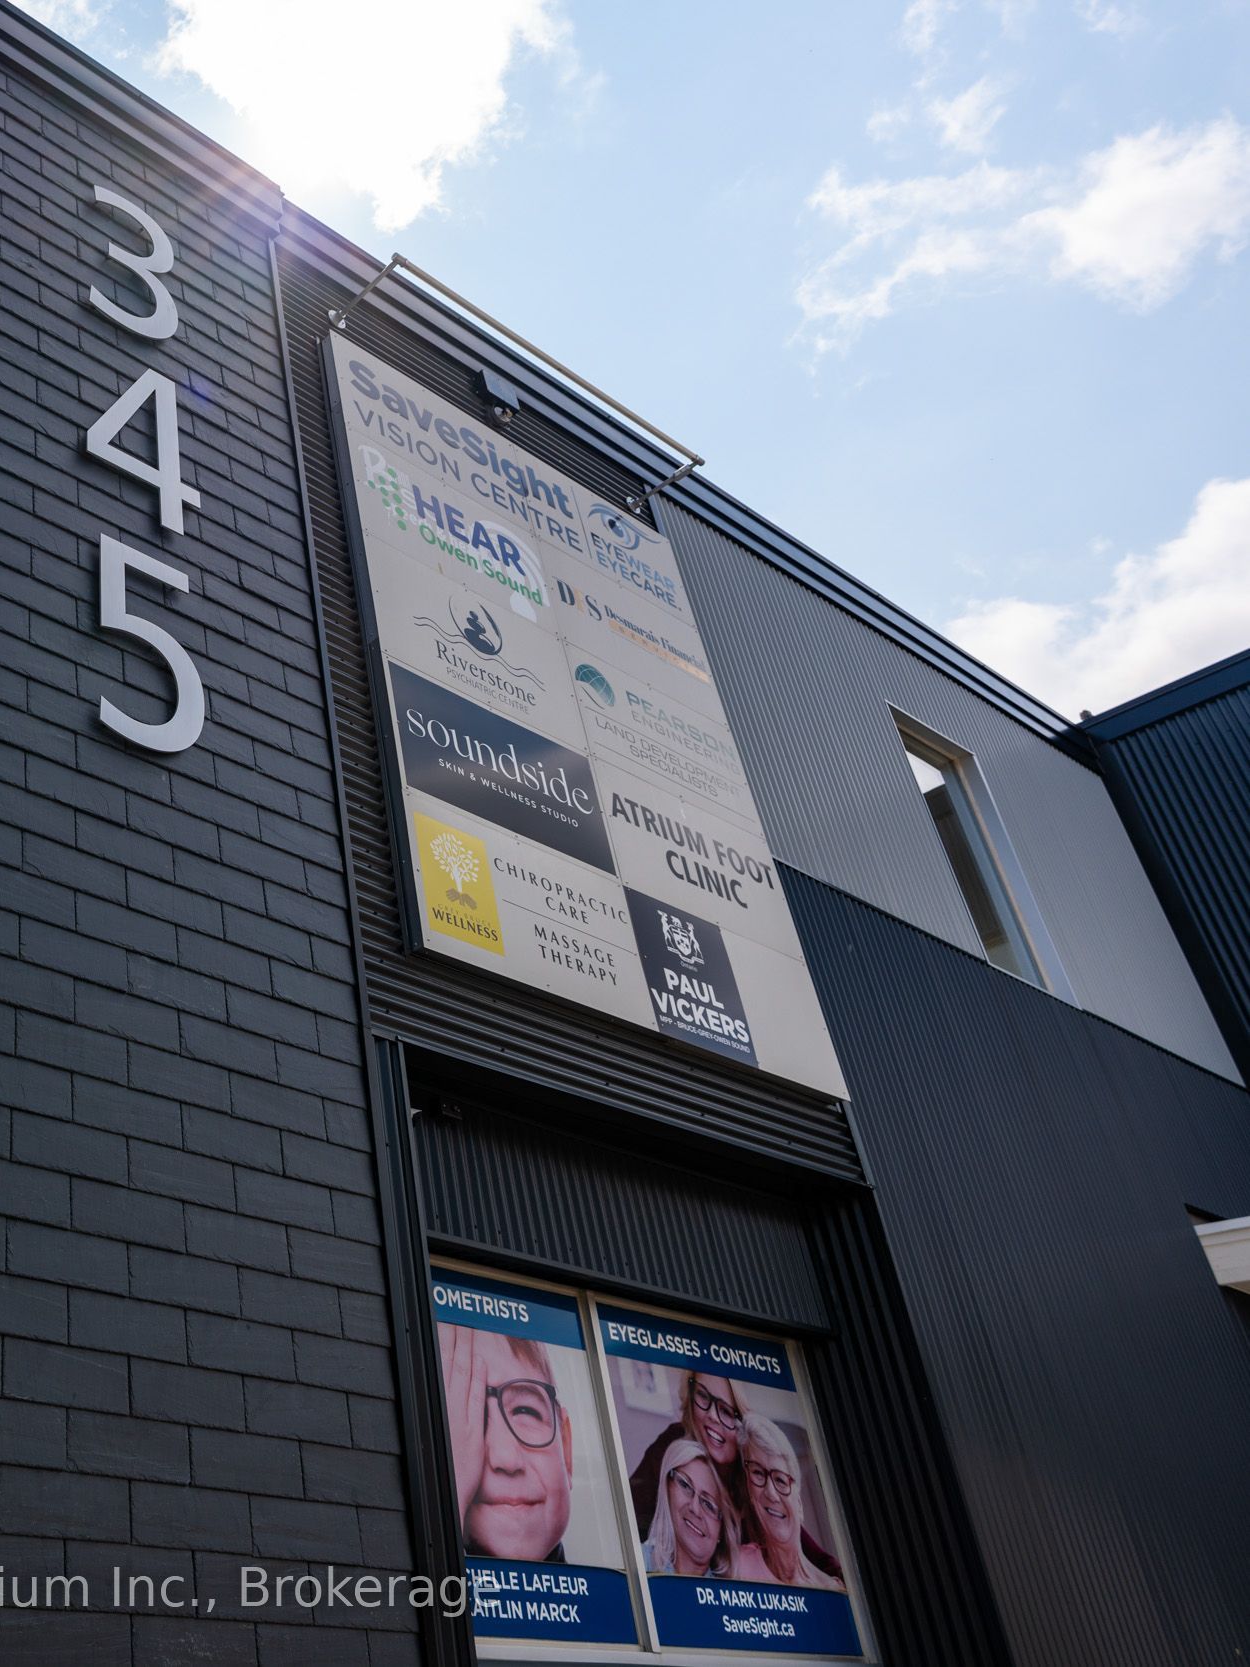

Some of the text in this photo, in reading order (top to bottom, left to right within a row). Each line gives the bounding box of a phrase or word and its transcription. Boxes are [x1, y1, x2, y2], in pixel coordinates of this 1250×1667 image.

[86, 184, 205, 753] 345
[349, 360, 574, 519] SaveSight
[353, 400, 461, 482] VISION
[470, 473, 583, 553] CENTRE
[412, 484, 526, 576] HEAR
[419, 524, 543, 606] Owen Sound
[591, 532, 676, 594] EYEWEAR
[435, 638, 536, 706] Riverstone
[446, 666, 529, 714] PSYCHIATRIC CENTRE
[625, 690, 736, 762] PEARSON
[631, 710, 741, 776] ENGINEERING
[406, 708, 594, 815] soundside
[595, 716, 740, 797] LAND DEVELOPMENT
[629, 744, 718, 798] SPECIALISTS
[438, 758, 579, 828] SKIN & WELLNESS STUDIO
[612, 792, 775, 890] ATRIUM FOOT
[493, 857, 628, 924] CHIROPRACTIC
[665, 850, 748, 909] CLINIC
[432, 907, 498, 941] WELLNESS
[545, 896, 590, 925] CARE
[534, 924, 615, 967] MASSAGE
[538, 944, 617, 986] THERAPY
[651, 987, 750, 1043] VICKERS
[663, 967, 725, 1010] PAUL
[433, 1286, 529, 1323] OMETRISTS
[607, 1322, 700, 1358] EYEGLASSES
[710, 1344, 782, 1375] CONTACTS
[466, 1568, 589, 1596] HELLE LAFLEUR
[470, 1598, 581, 1623] AITLIN MARCK
[696, 1587, 808, 1613] DR. MARK LUKASIK
[722, 1615, 795, 1638] SaveSight.ca
